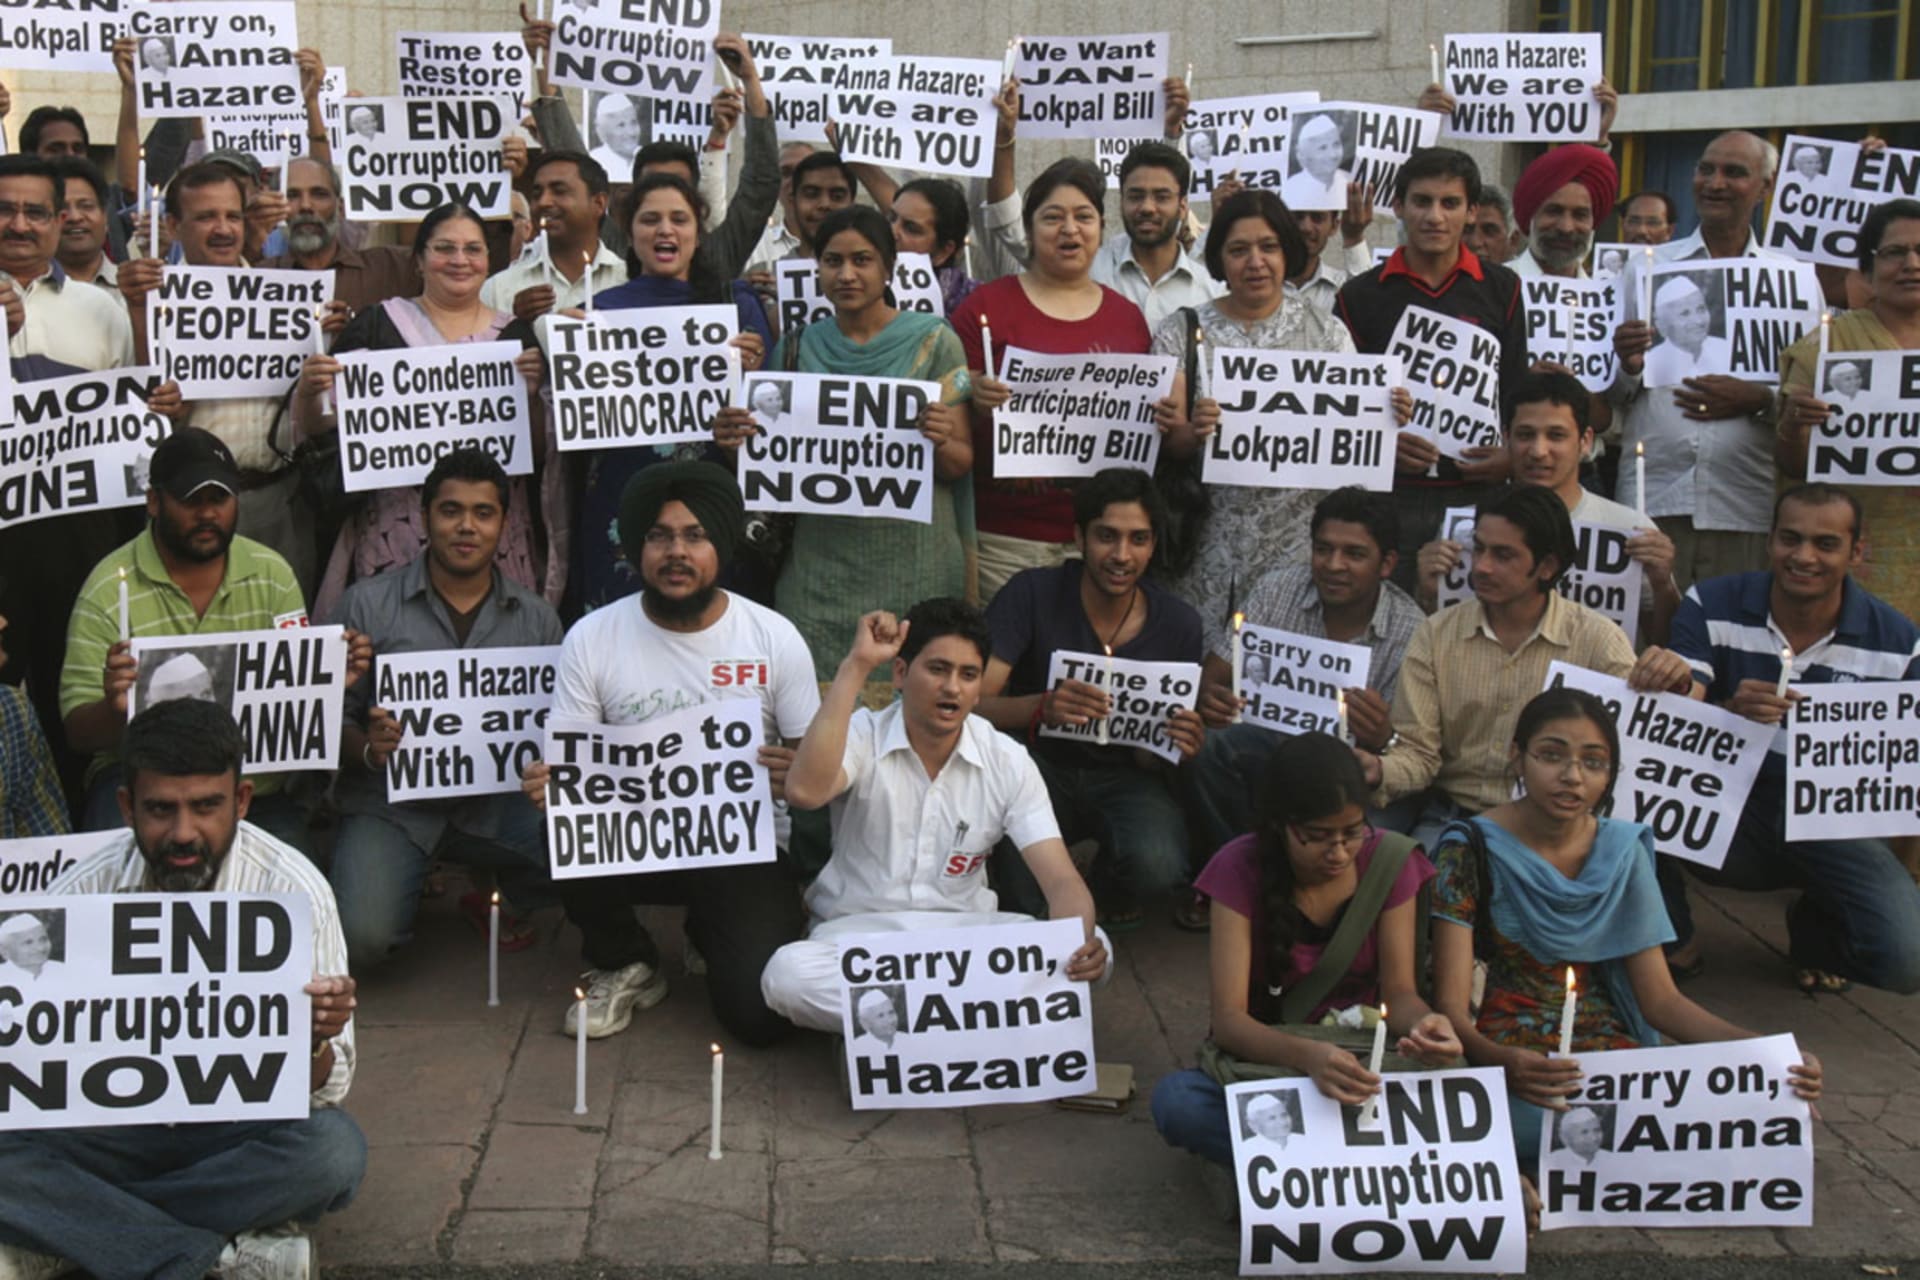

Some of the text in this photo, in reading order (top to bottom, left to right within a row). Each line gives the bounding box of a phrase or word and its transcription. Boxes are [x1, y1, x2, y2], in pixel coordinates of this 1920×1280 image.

[131, 11, 276, 38] Carry on,
[620, 0, 711, 29] END
[0, 17, 89, 58] Lokpal
[180, 43, 293, 68] Anna
[401, 38, 523, 61] Time to
[558, 14, 706, 62] Corruption
[748, 40, 879, 60] We Want
[1021, 40, 1155, 61] We Want
[1446, 39, 1586, 69] Anna Hazare:
[401, 57, 522, 87] Restore
[555, 51, 703, 94] NOW
[834, 63, 984, 97] Anna Hazare:
[1021, 66, 1153, 85] JAN-
[1451, 73, 1584, 95] We are
[142, 81, 297, 109] Hazare
[838, 94, 978, 126] We are
[1018, 91, 1154, 128] Lokpal Bill
[407, 100, 502, 140] END
[1184, 108, 1254, 129] Carry
[1450, 102, 1588, 134] With YOU
[348, 144, 503, 183] Corruption
[835, 122, 981, 168] With YOU
[349, 182, 502, 211] NOW
[1779, 182, 1874, 225] Corru
[159, 273, 324, 302] We Want
[897, 264, 931, 289] to
[1527, 282, 1615, 308] Want
[1726, 267, 1809, 310] HAIL
[554, 317, 729, 352] Time to
[1405, 312, 1458, 351] We
[344, 356, 514, 399] We Condemn
[553, 350, 728, 391] Restore
[1006, 358, 1166, 389] Ensure Peoples'
[1221, 355, 1387, 387] We Want
[345, 395, 516, 436] MONEY-BAG
[818, 379, 927, 430] END
[1218, 390, 1384, 417] JAN-
[746, 424, 925, 474] Corruption
[998, 423, 1153, 464] Drafting Bill
[1211, 423, 1383, 472] Lokpal Bill
[0, 459, 98, 521] END
[745, 470, 922, 509] NOW
[237, 638, 332, 692] HAIL
[1242, 631, 1352, 674] Carry on
[379, 658, 556, 703] Anna Hazare
[711, 664, 767, 687] SFI
[1062, 658, 1147, 691] Time
[1160, 674, 1192, 696] to
[387, 707, 463, 737] We
[1795, 696, 1888, 723] Ensure
[239, 698, 326, 764] ANNA
[552, 715, 752, 767] Time to
[1626, 695, 1746, 765] Hazare:
[388, 740, 543, 791] With YO
[550, 760, 754, 807] Restore
[1634, 757, 1724, 797] are
[554, 800, 761, 867] DEMOCRACY
[1634, 790, 1720, 851] YOU
[112, 900, 292, 975] END
[841, 943, 1057, 987] Carry on,
[0, 980, 289, 1055] Corruption
[913, 990, 1081, 1034] Anna
[0, 1052, 288, 1112] NOW
[856, 1049, 1087, 1095] Hazare
[1707, 1063, 1778, 1100] on,
[1340, 1076, 1492, 1146] END
[1617, 1114, 1802, 1153] Anna
[1247, 1149, 1503, 1220] Corruption
[1548, 1170, 1803, 1214] Hazare
[1250, 1216, 1505, 1265] NOW
